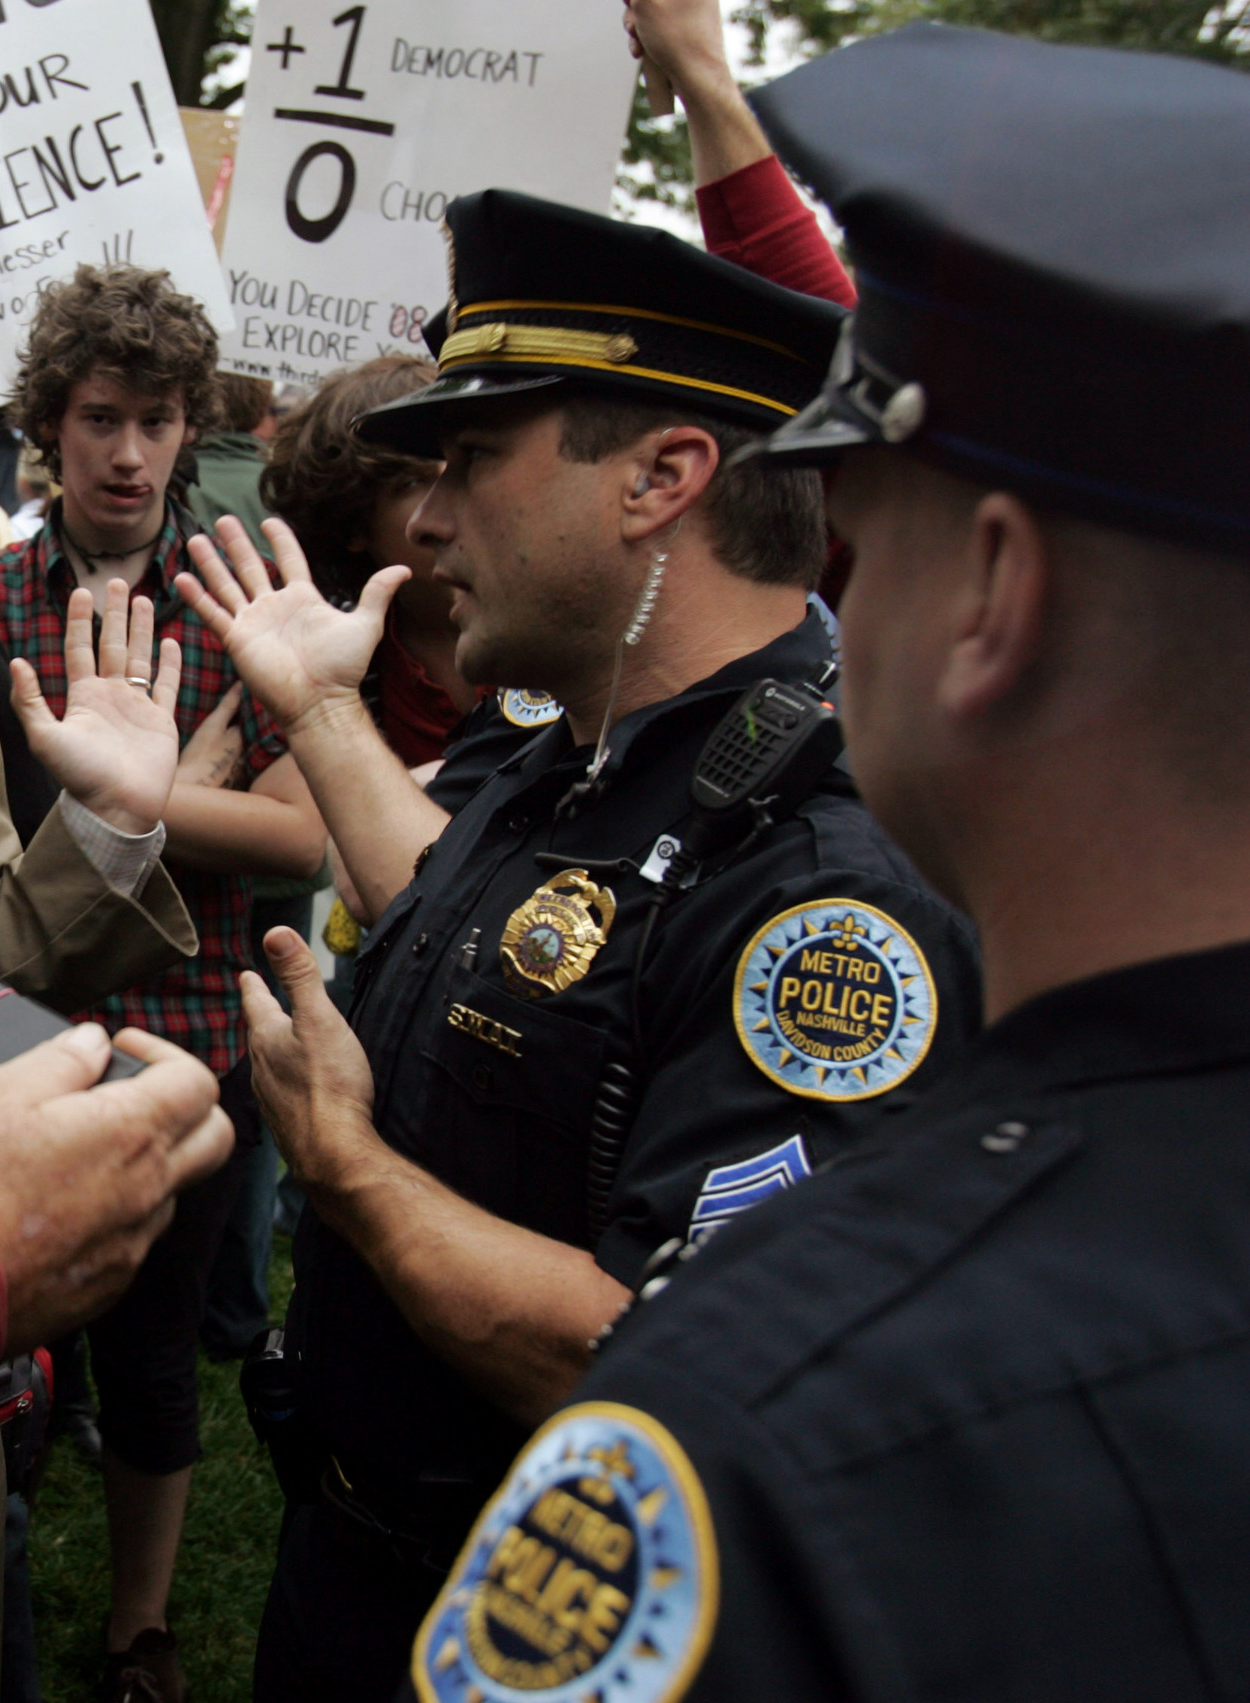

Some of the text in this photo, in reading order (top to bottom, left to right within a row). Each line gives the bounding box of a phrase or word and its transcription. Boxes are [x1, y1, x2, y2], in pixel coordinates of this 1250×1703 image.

[390, 38, 545, 87] DEMOCRAT
[379, 181, 460, 224] CHO
[286, 279, 380, 332] DECIDE
[242, 316, 361, 363] EXPLORE
[800, 949, 881, 984] METRO
[779, 977, 893, 1027] POLICE
[796, 1011, 866, 1037] NASHVILLE
[776, 1010, 887, 1061] DAVIDSON COUNTY
